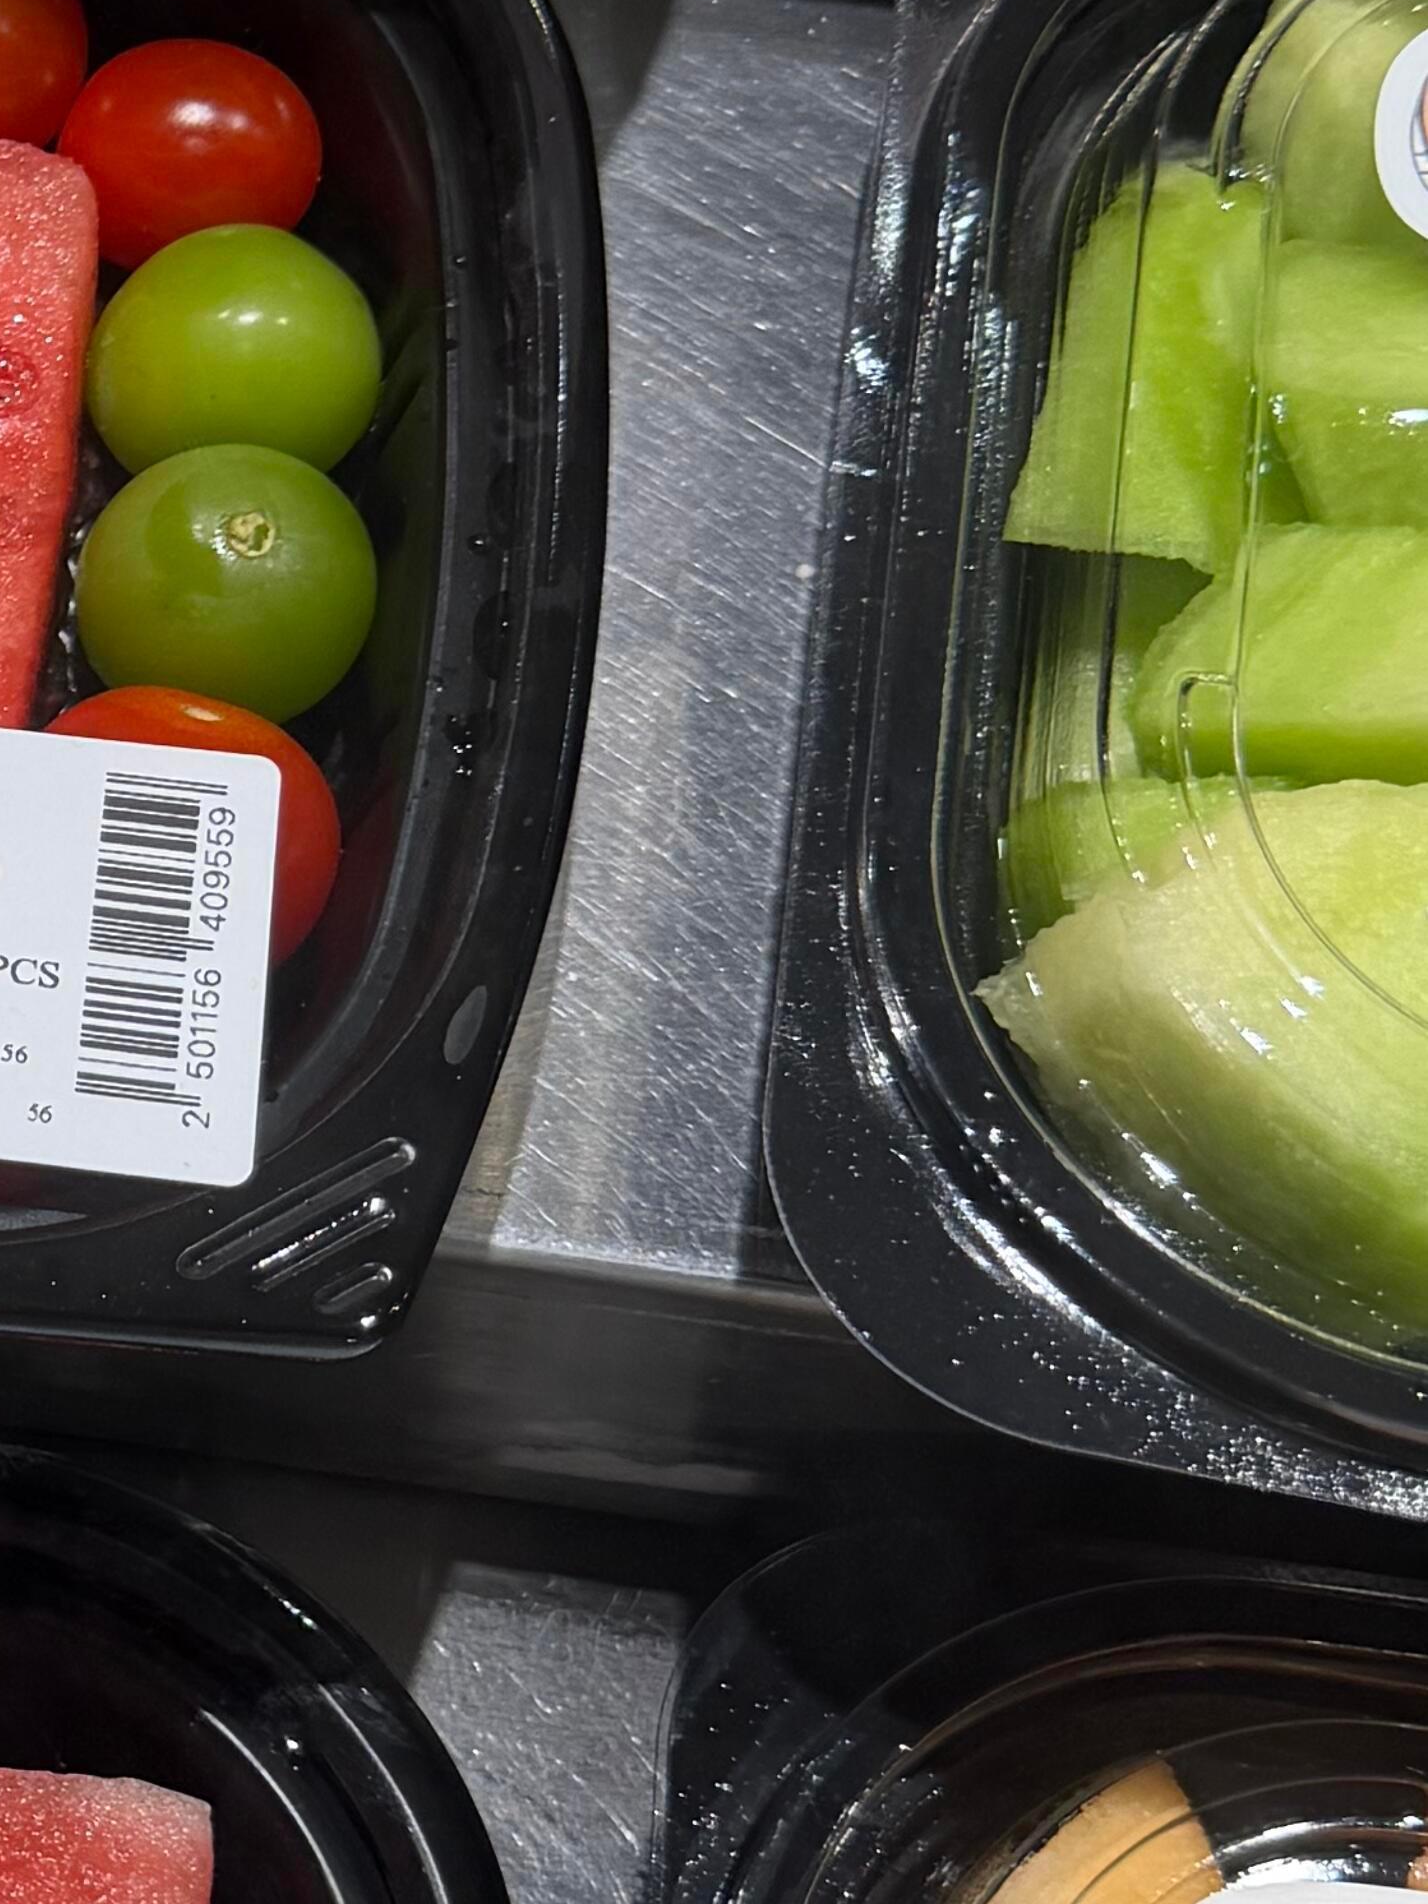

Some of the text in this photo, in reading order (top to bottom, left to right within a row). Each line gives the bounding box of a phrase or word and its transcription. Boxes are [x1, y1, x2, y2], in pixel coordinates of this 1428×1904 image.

[181, 807, 236, 1130] 2 501156 409559
[27, 1103, 54, 1124] 56
